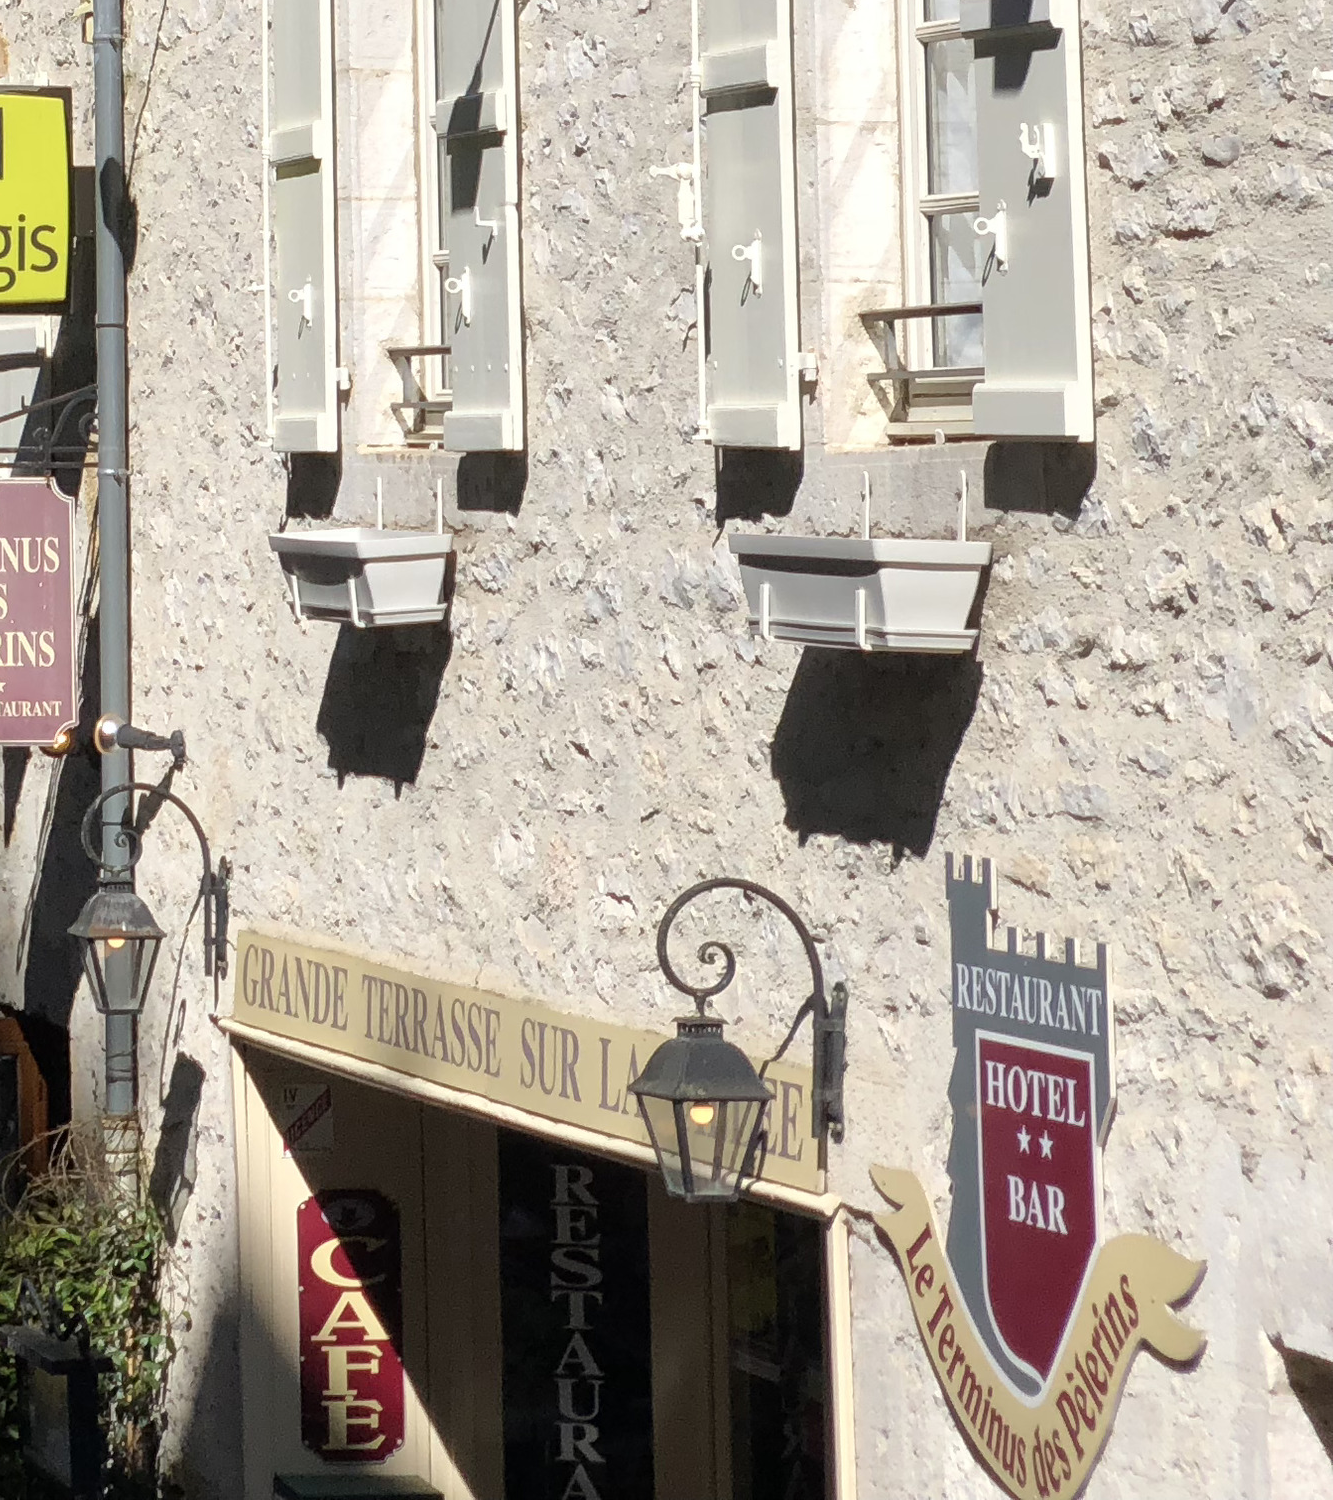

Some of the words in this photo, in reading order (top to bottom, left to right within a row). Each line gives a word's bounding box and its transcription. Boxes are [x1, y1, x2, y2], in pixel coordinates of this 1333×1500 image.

[242, 943, 349, 1031] GRANDE
[362, 974, 502, 1078] TERRASSE
[520, 1017, 581, 1103] SUR
[955, 963, 1103, 1037] RESTAURANT
[984, 1060, 1086, 1128] HOTEL
[1006, 1174, 1069, 1236] BAR
[906, 1222, 935, 1298] Le
[925, 1282, 1028, 1490] Terminus
[1032, 1423, 1072, 1498] des
